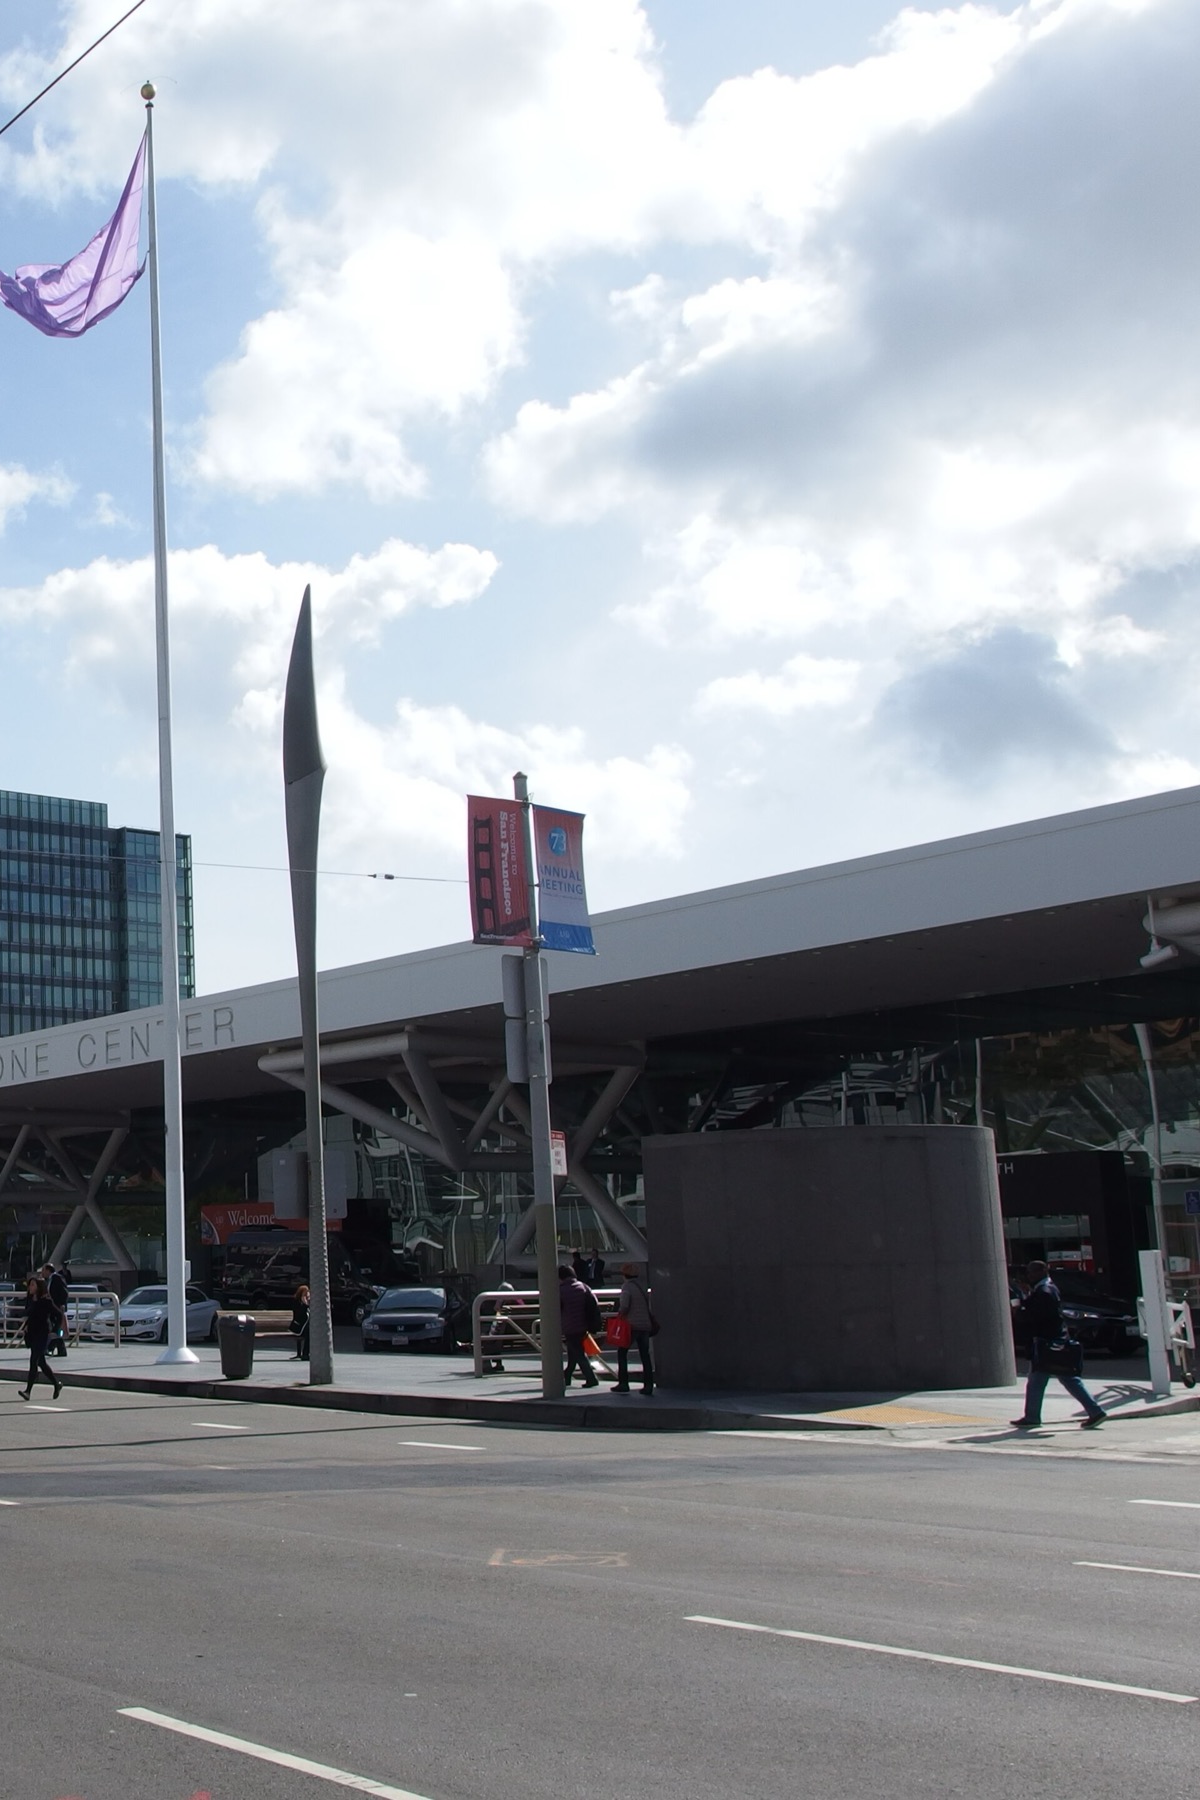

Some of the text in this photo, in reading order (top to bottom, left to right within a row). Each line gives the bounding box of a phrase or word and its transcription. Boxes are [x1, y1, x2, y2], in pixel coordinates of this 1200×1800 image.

[500, 811, 512, 915] San Francisco
[509, 813, 518, 876] Welcome to
[77, 1006, 236, 1069] CENER
[227, 1209, 276, 1226] Welcome
